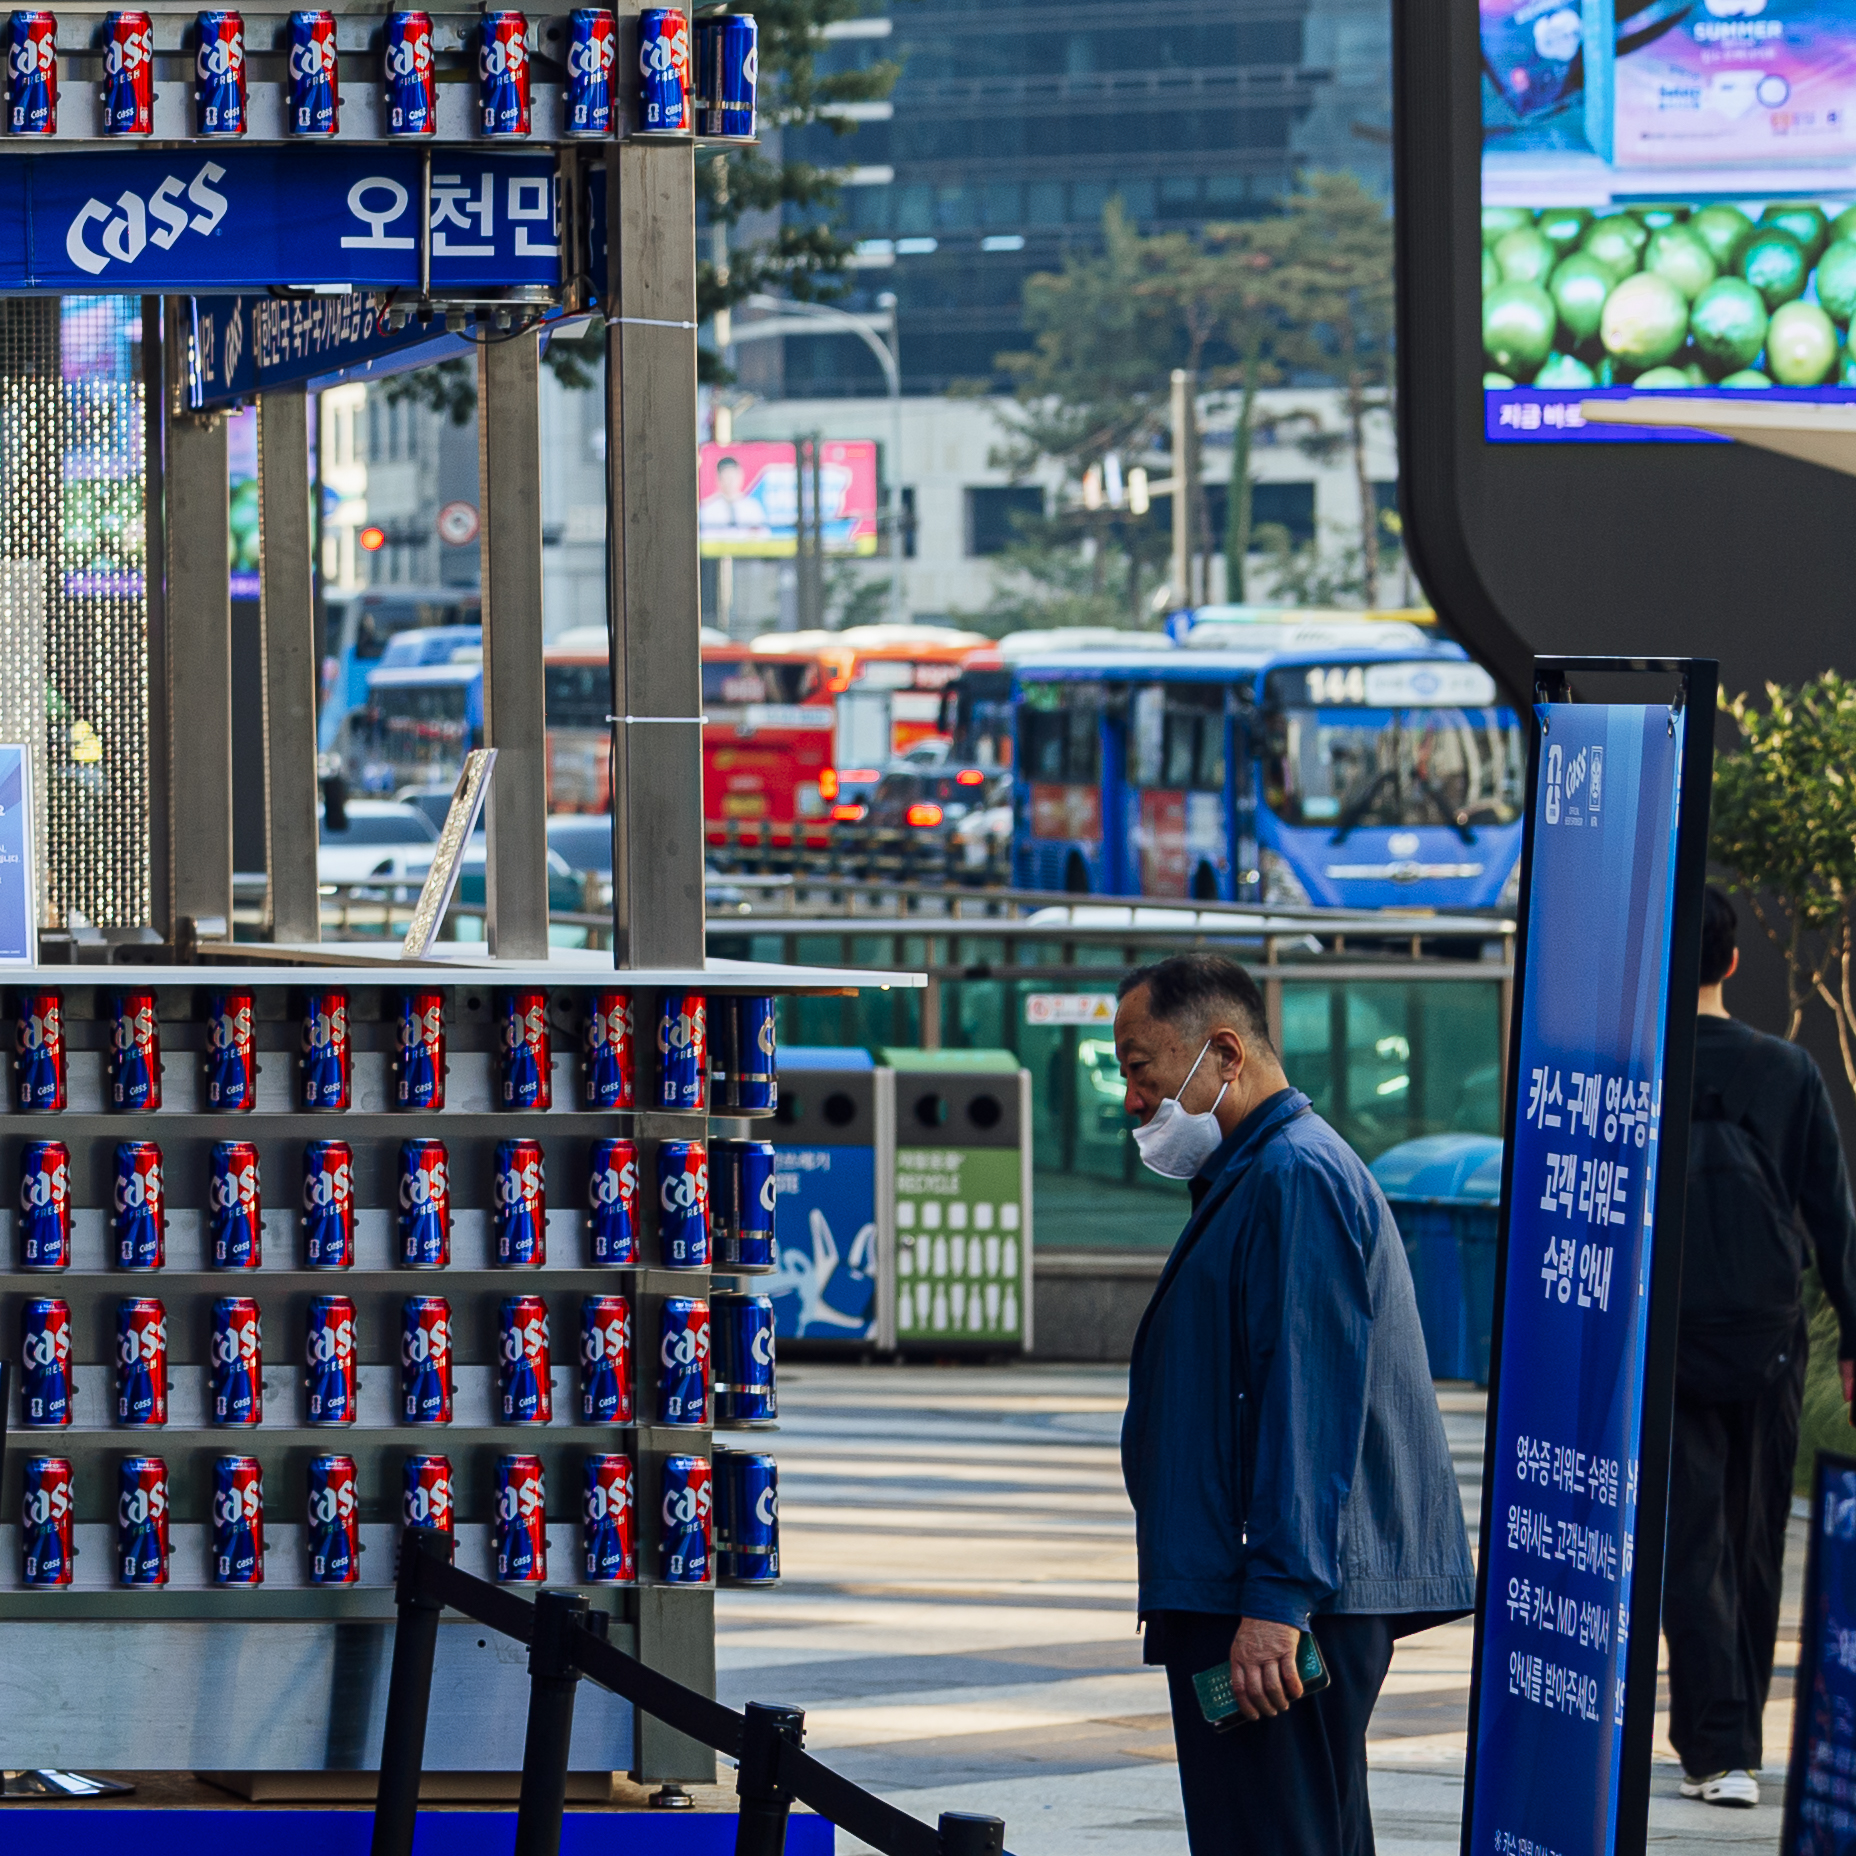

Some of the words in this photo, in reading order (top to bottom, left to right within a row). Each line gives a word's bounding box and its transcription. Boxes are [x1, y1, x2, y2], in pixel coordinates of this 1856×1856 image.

[1306, 667, 1364, 704] 144
[1527, 1066, 1563, 1129] 카스
[1567, 1072, 1602, 1138] 구매
[1604, 1077, 1650, 1148] 영수증
[1540, 1152, 1577, 1219] 고객
[1578, 1158, 1629, 1226] 리워드
[1541, 1236, 1576, 1304] 수령
[1577, 1244, 1613, 1312] 안내
[1517, 1435, 1550, 1487] 영수증
[1553, 1446, 1585, 1494] 리워드
[1588, 1455, 1619, 1507] 수령을
[1507, 1505, 1552, 1560] 원하시는
[1507, 1577, 1531, 1625] 우측
[1533, 1585, 1554, 1631] 카스
[1556, 1596, 1577, 1637] MD
[1509, 1651, 1542, 1703] 안내를
[1545, 1663, 1599, 1722] 받아주세요.
